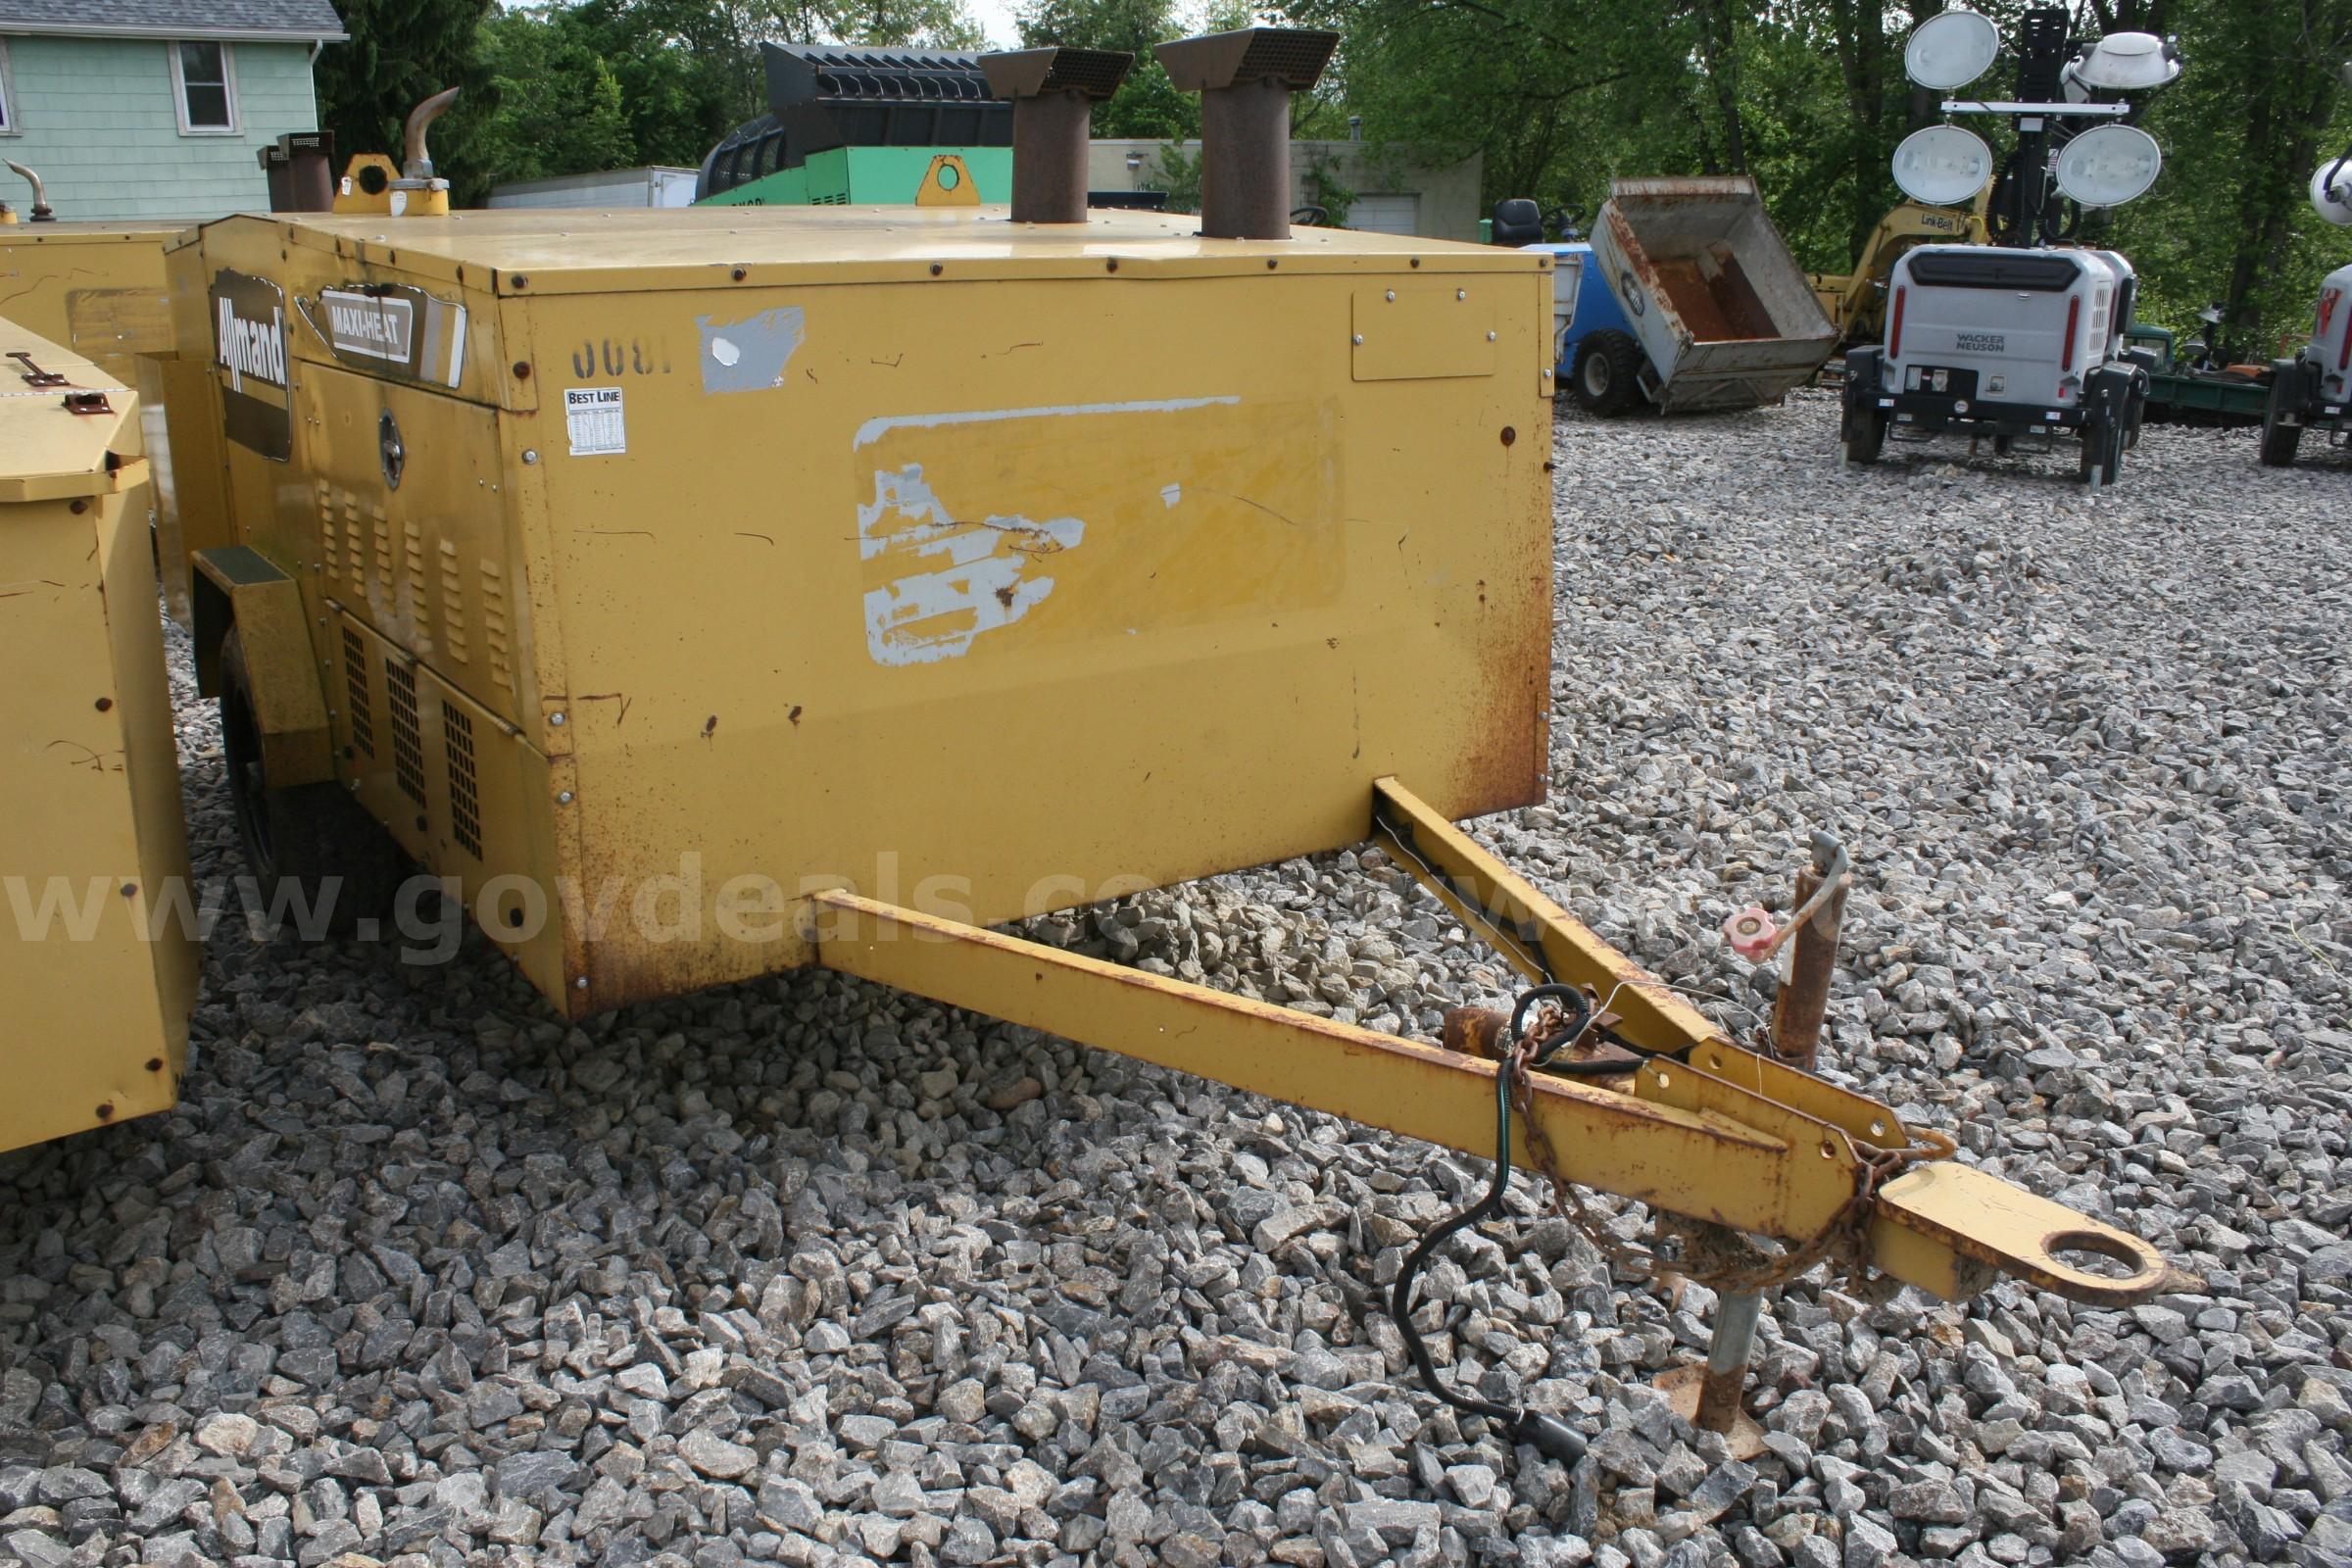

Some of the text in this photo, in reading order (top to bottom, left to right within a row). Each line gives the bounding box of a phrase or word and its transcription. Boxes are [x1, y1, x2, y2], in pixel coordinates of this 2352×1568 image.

[331, 305, 398, 345] MAXI-HEAT
[219, 297, 286, 393] Allmand
[1957, 334, 2004, 344] WACKER
[1956, 342, 2004, 353] NEUSON
[568, 391, 619, 404] BEST LINE
